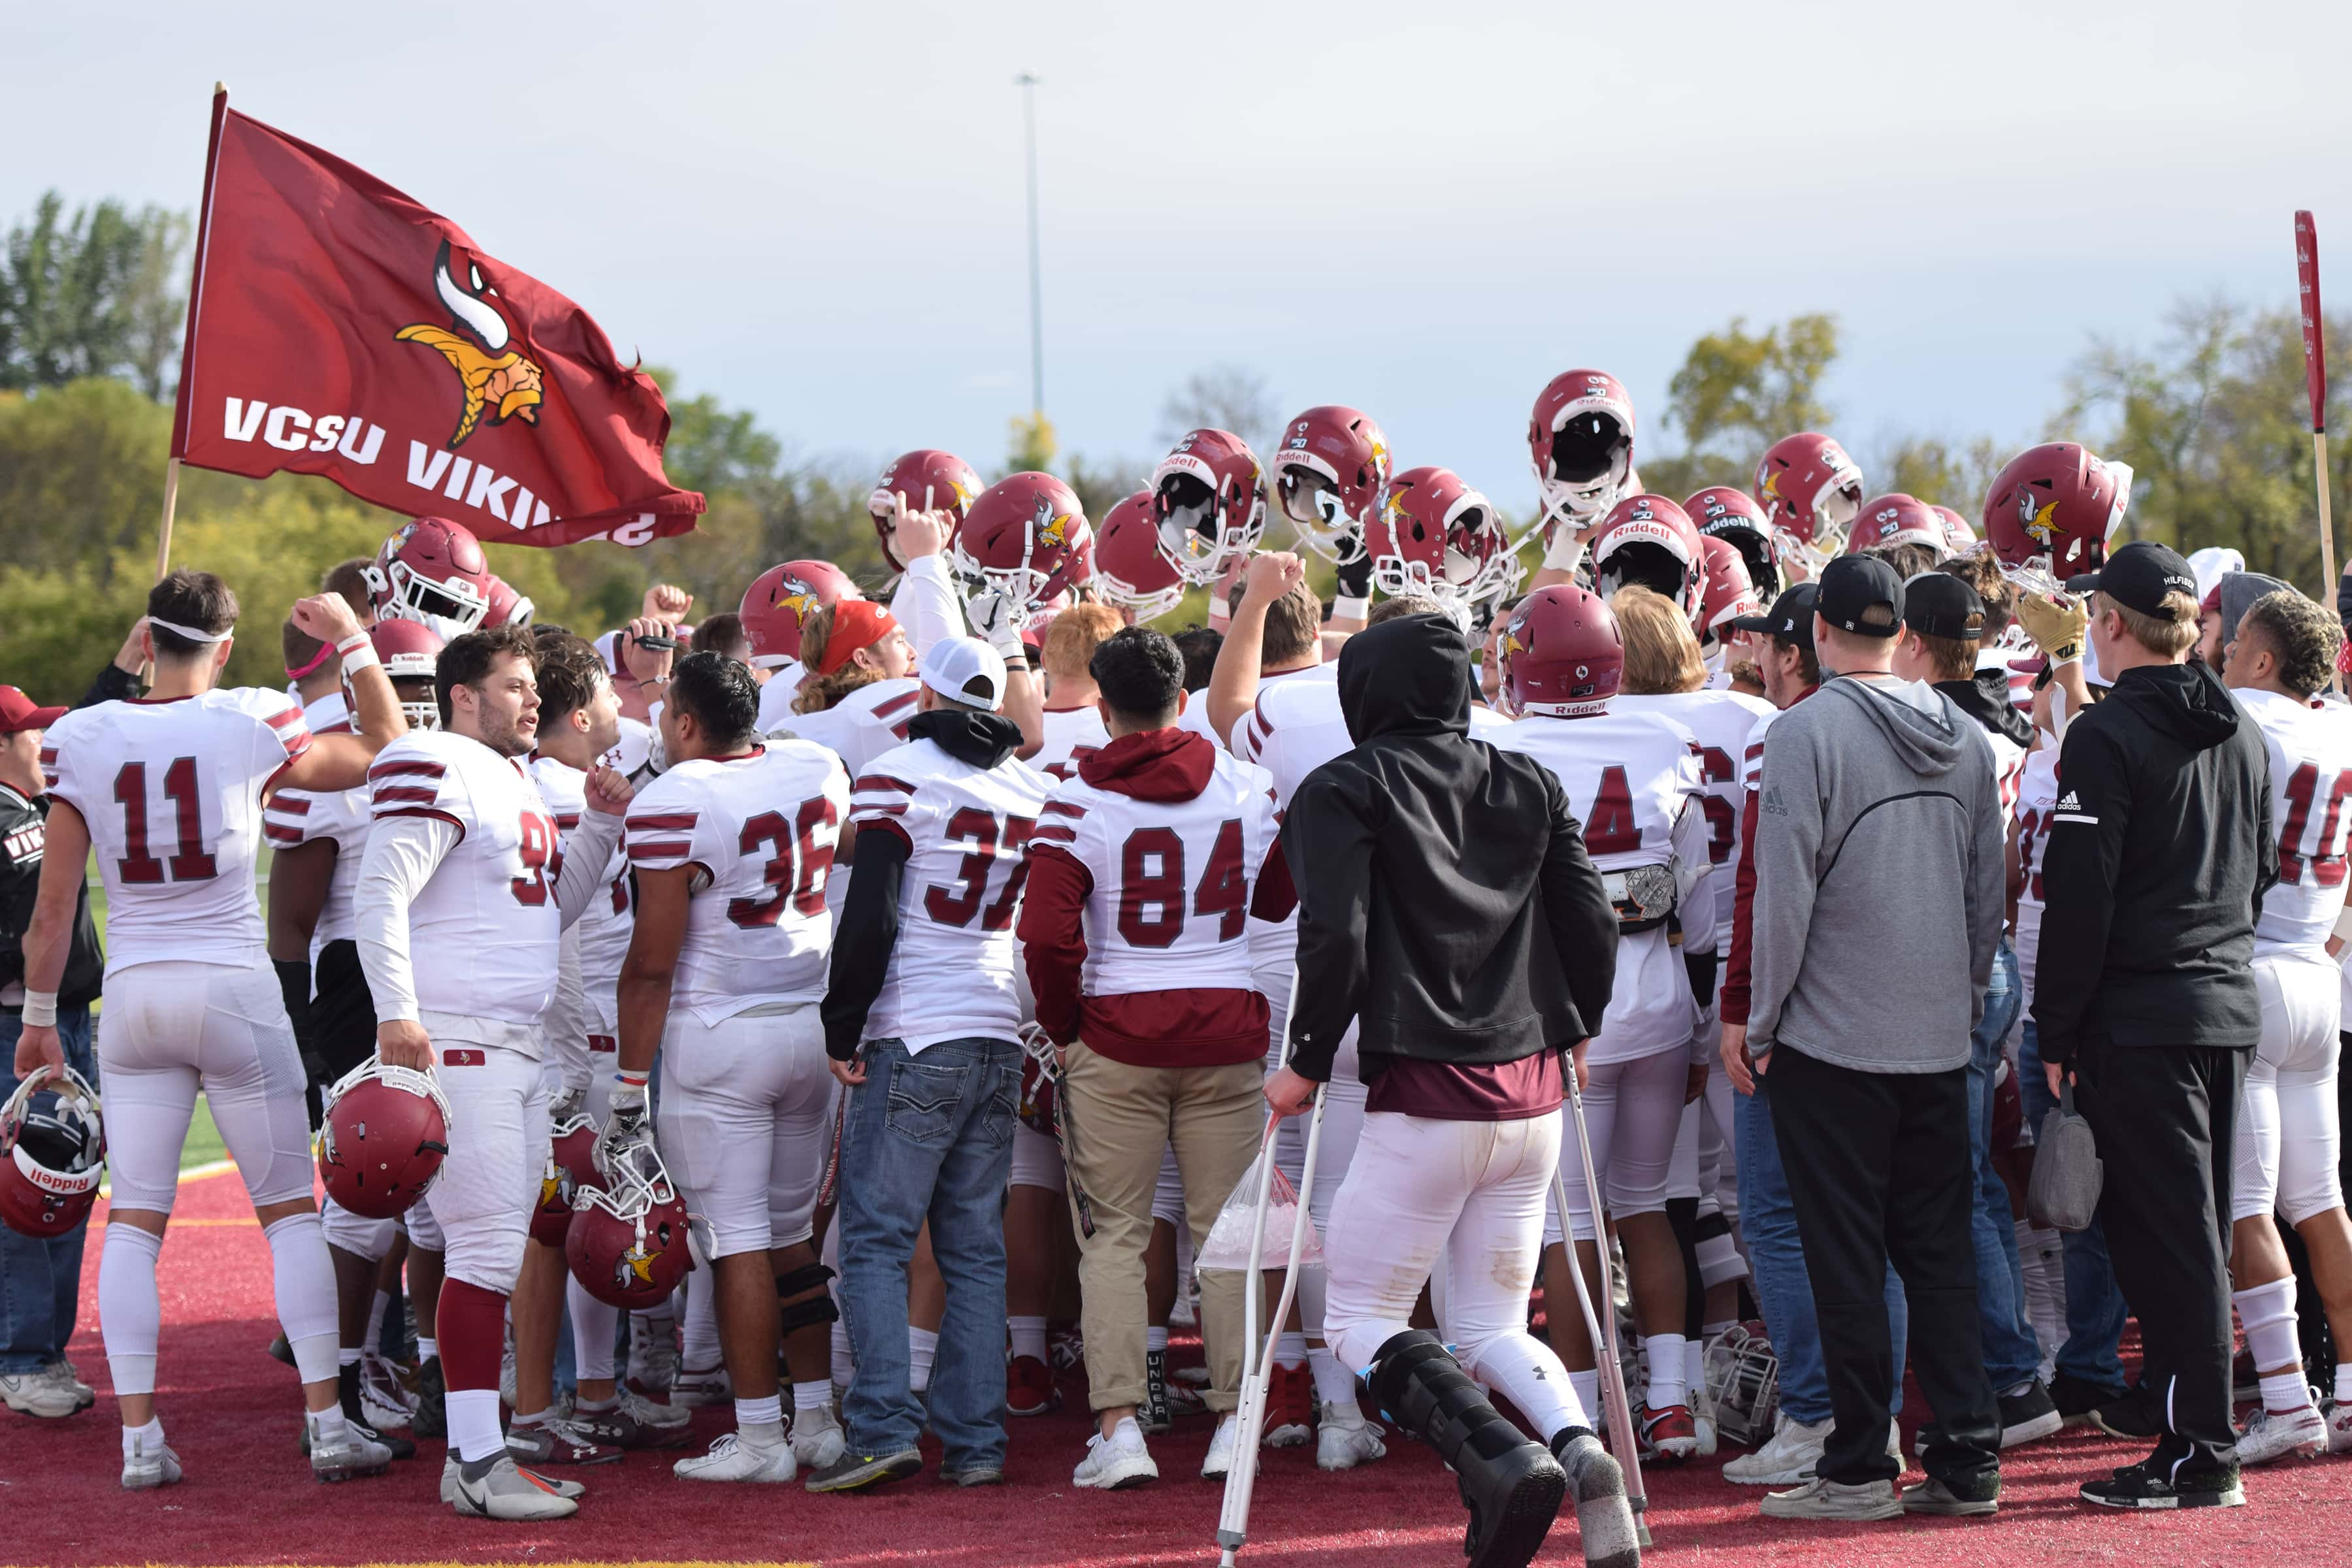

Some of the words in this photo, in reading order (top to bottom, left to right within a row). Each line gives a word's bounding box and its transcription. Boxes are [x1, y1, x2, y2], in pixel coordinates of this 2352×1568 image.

[224, 397, 386, 465] VCSU
[1275, 451, 1311, 464] Riddell
[1613, 523, 1671, 541] Riddell
[1699, 515, 1751, 535] Riddell
[1556, 702, 1606, 715] Riddell
[114, 756, 218, 883] 11
[1582, 765, 1642, 855] 4
[726, 794, 838, 930] 36
[924, 806, 1037, 932] 37
[1117, 817, 1250, 949] 84
[30, 1168, 89, 1192] Riddell
[1147, 1356, 1166, 1416] UNDER
